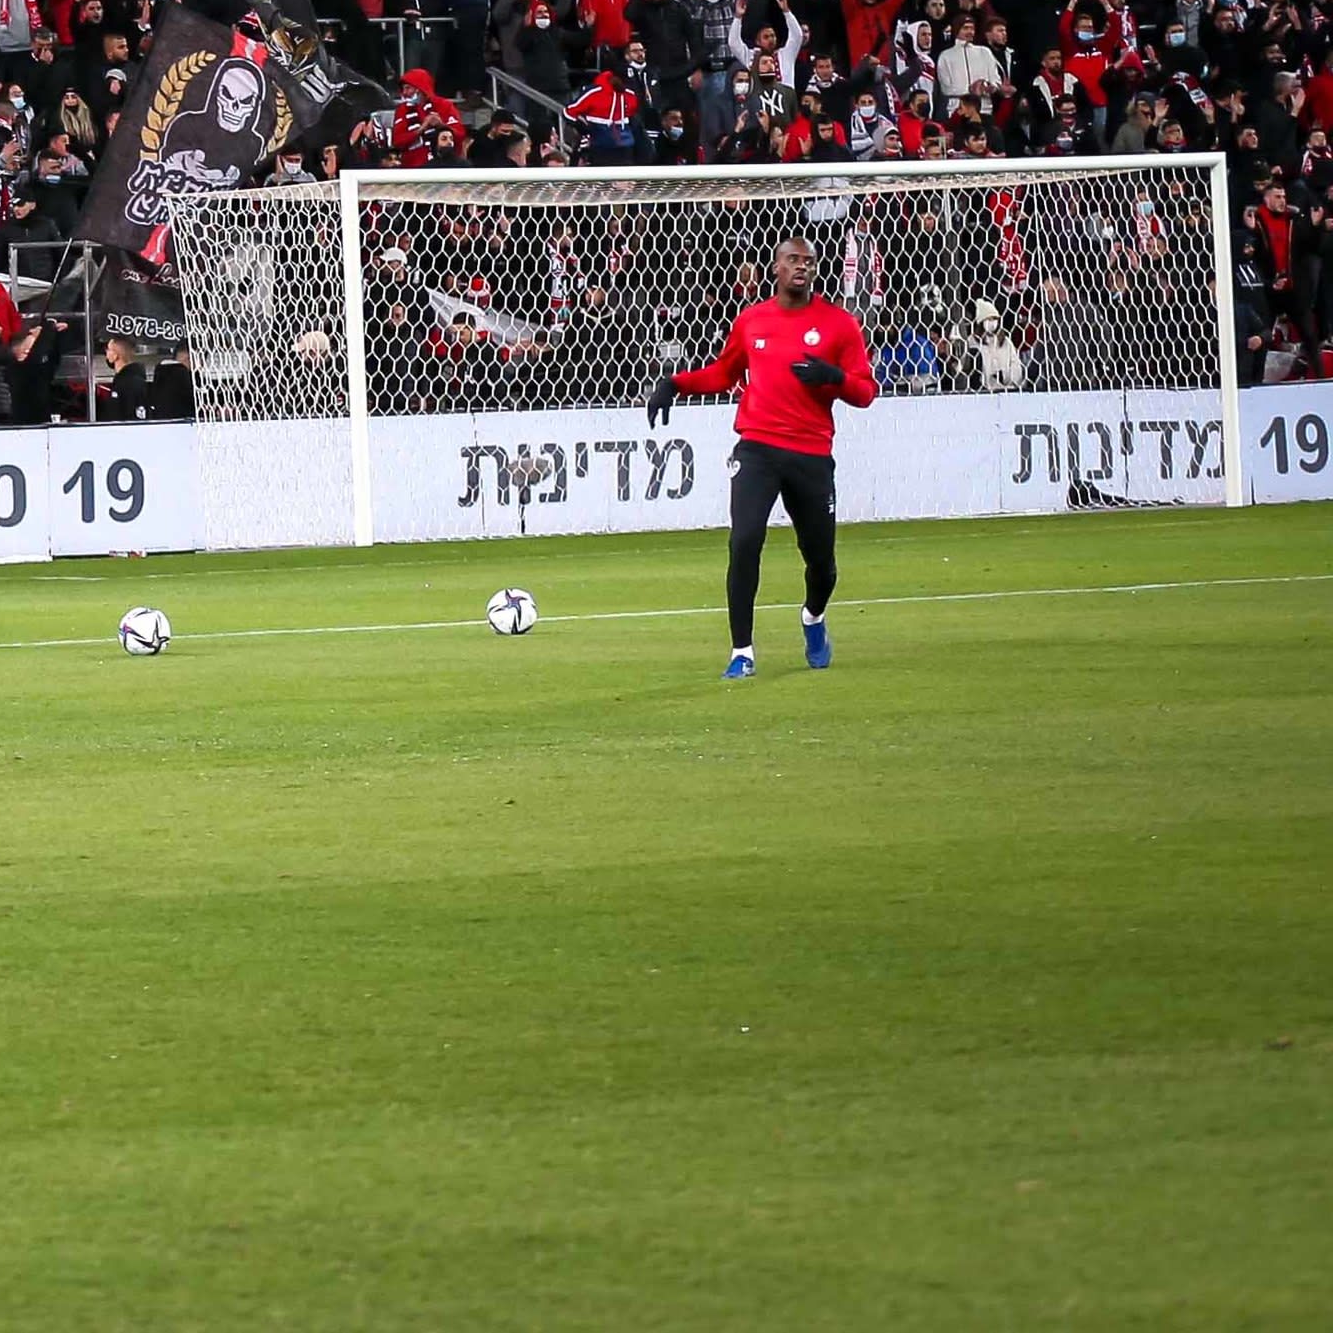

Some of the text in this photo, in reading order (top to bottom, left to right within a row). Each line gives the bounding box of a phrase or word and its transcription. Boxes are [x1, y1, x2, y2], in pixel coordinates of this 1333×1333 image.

[458, 438, 695, 508] מדינות
[1012, 414, 1329, 484] 19 מדינות
[63, 458, 145, 523] 19
